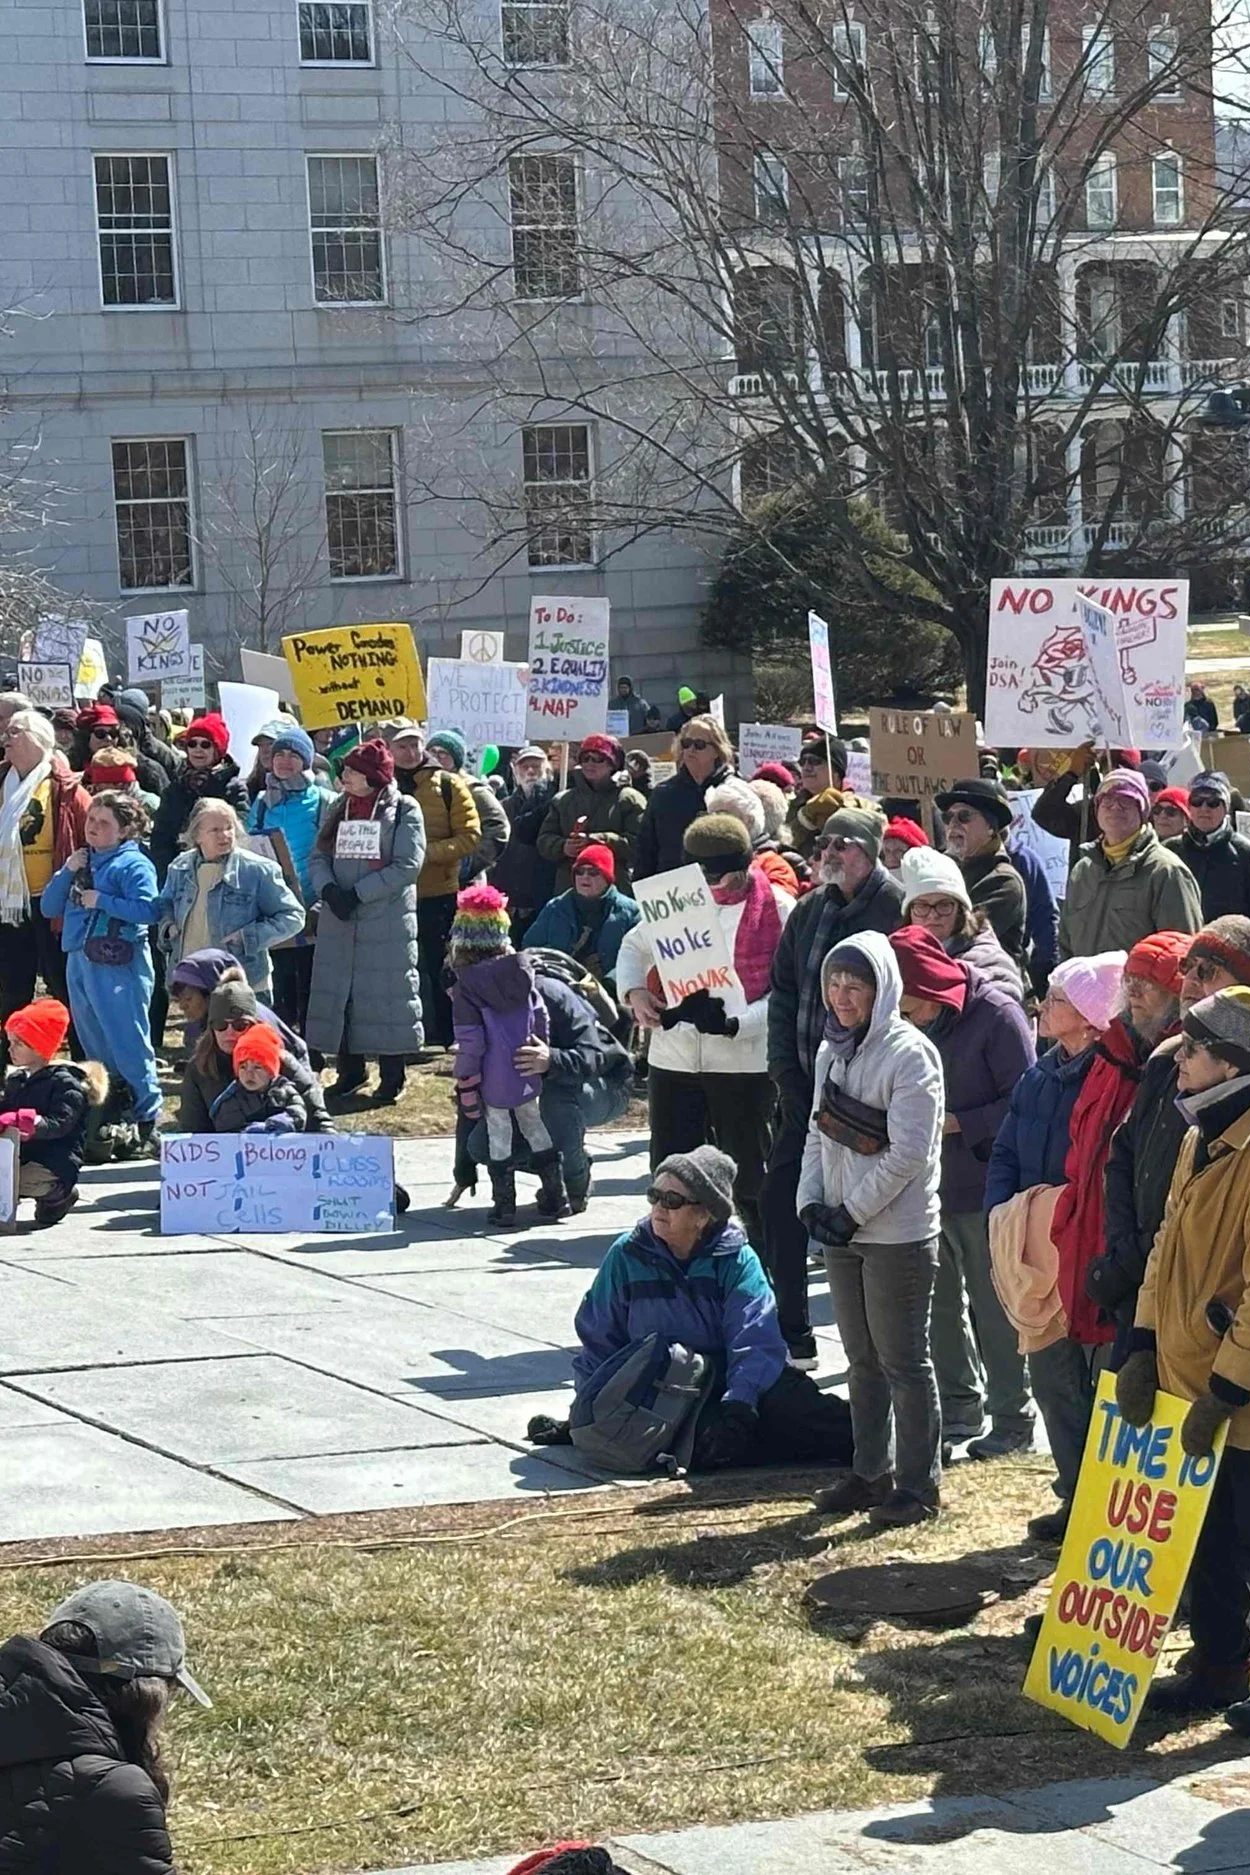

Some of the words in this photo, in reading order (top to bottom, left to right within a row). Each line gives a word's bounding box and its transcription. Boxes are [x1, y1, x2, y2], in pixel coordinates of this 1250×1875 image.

[997, 585, 1054, 615] NO
[143, 616, 176, 636] NO
[535, 607, 551, 624] To
[137, 650, 185, 672] KINGS
[292, 638, 342, 663] Power
[330, 651, 398, 670] NOTHING
[990, 655, 1018, 669] Join
[21, 668, 43, 682] NO
[318, 676, 361, 694] without
[375, 677, 386, 687] a
[335, 698, 405, 721] DEMAND
[449, 688, 523, 714] PROTECT
[542, 700, 578, 719] NAP
[473, 721, 524, 742] OTHER
[881, 714, 909, 735] RULE
[913, 716, 929, 735] OF
[938, 718, 961, 737] LAW
[907, 746, 926, 765] OR
[642, 899, 669, 924] NO
[656, 937, 685, 960] NO
[684, 926, 713, 951] ICE
[668, 978, 698, 1003] NO
[698, 966, 733, 989] WAR
[163, 1140, 221, 1164] KIDS
[244, 1141, 307, 1171] Belong
[319, 1140, 334, 1152] in
[166, 1179, 217, 1201] NOT
[214, 1181, 277, 1200] JAIL
[1098, 1400, 1174, 1480] TIME
[1179, 1448, 1216, 1487] TO
[1107, 1478, 1177, 1543] USE
[1088, 1538, 1155, 1598] OUR
[1058, 1580, 1169, 1658] OUTSIDE
